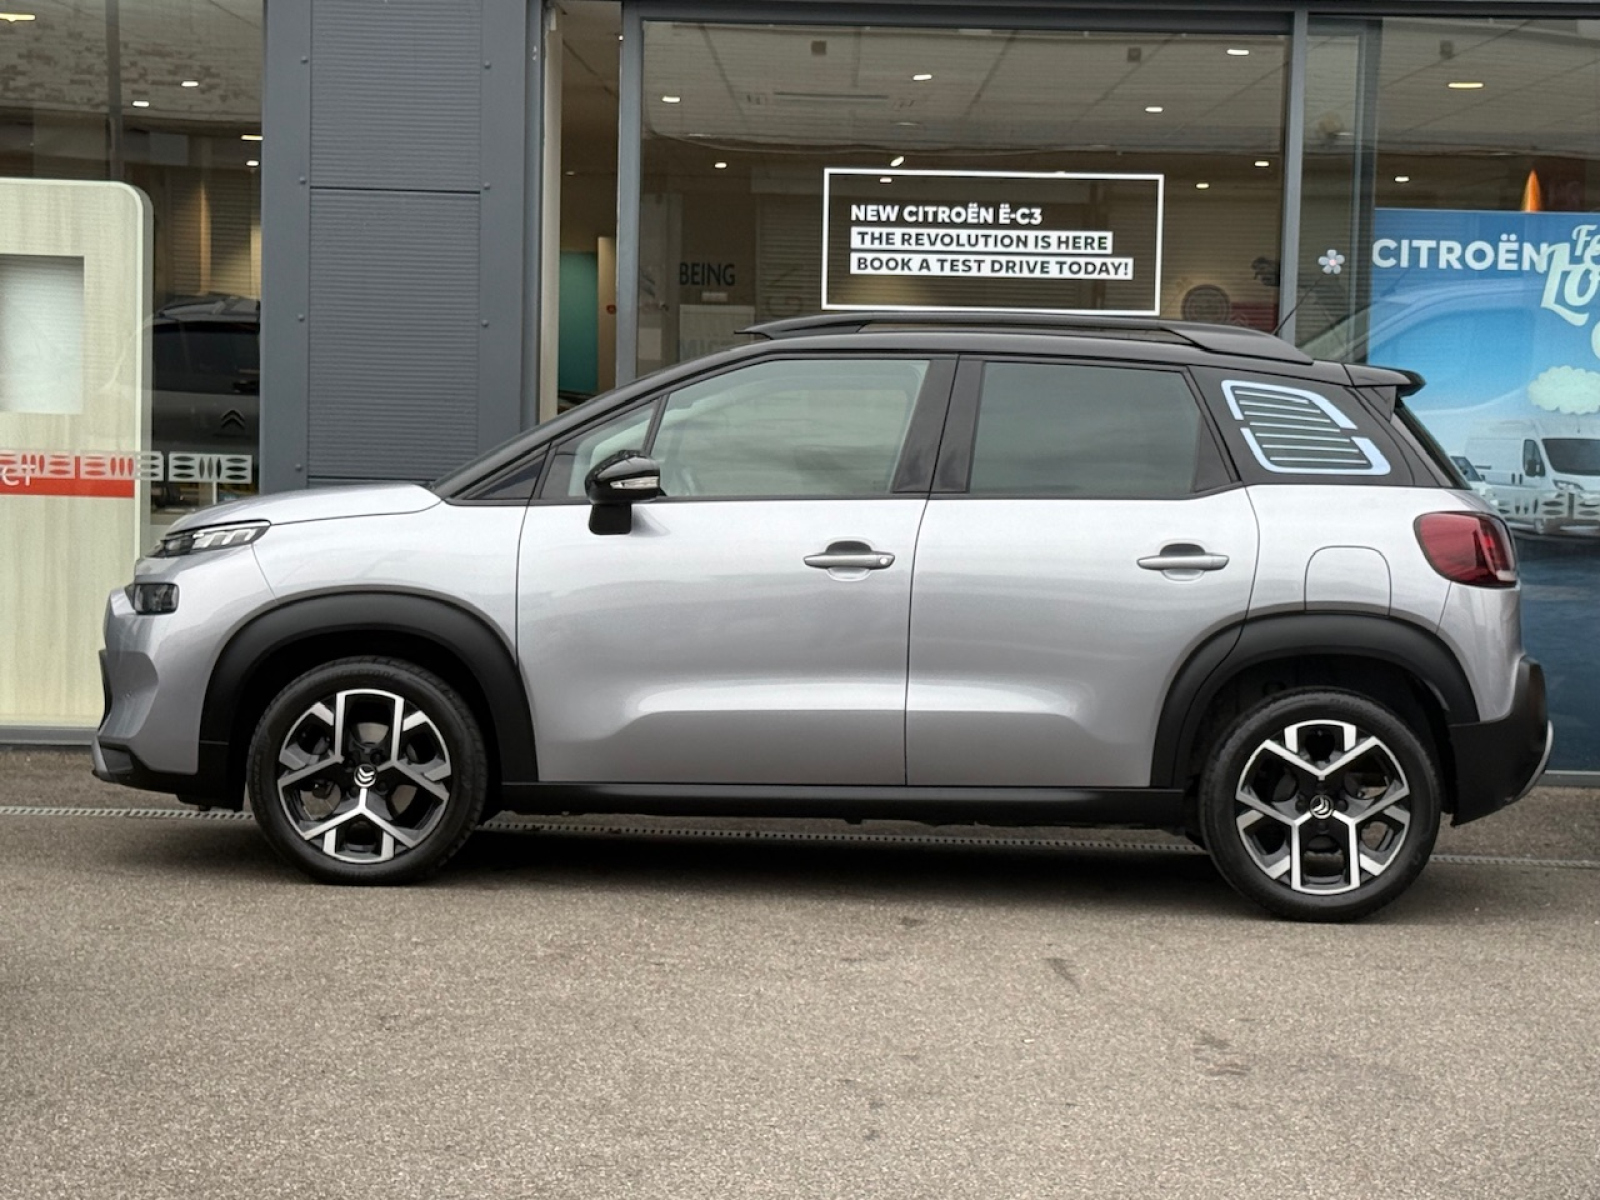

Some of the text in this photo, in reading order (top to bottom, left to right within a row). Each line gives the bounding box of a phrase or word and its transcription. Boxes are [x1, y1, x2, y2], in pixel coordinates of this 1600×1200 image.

[851, 202, 1042, 225] NEW CITROËN Ë-C3
[857, 231, 1108, 251] THE REVOLUTION IS HERE
[1372, 233, 1548, 271] CITROËN
[679, 262, 736, 286] BEING
[857, 257, 1129, 276] BOOK A TEST DRIVE TODAY!
